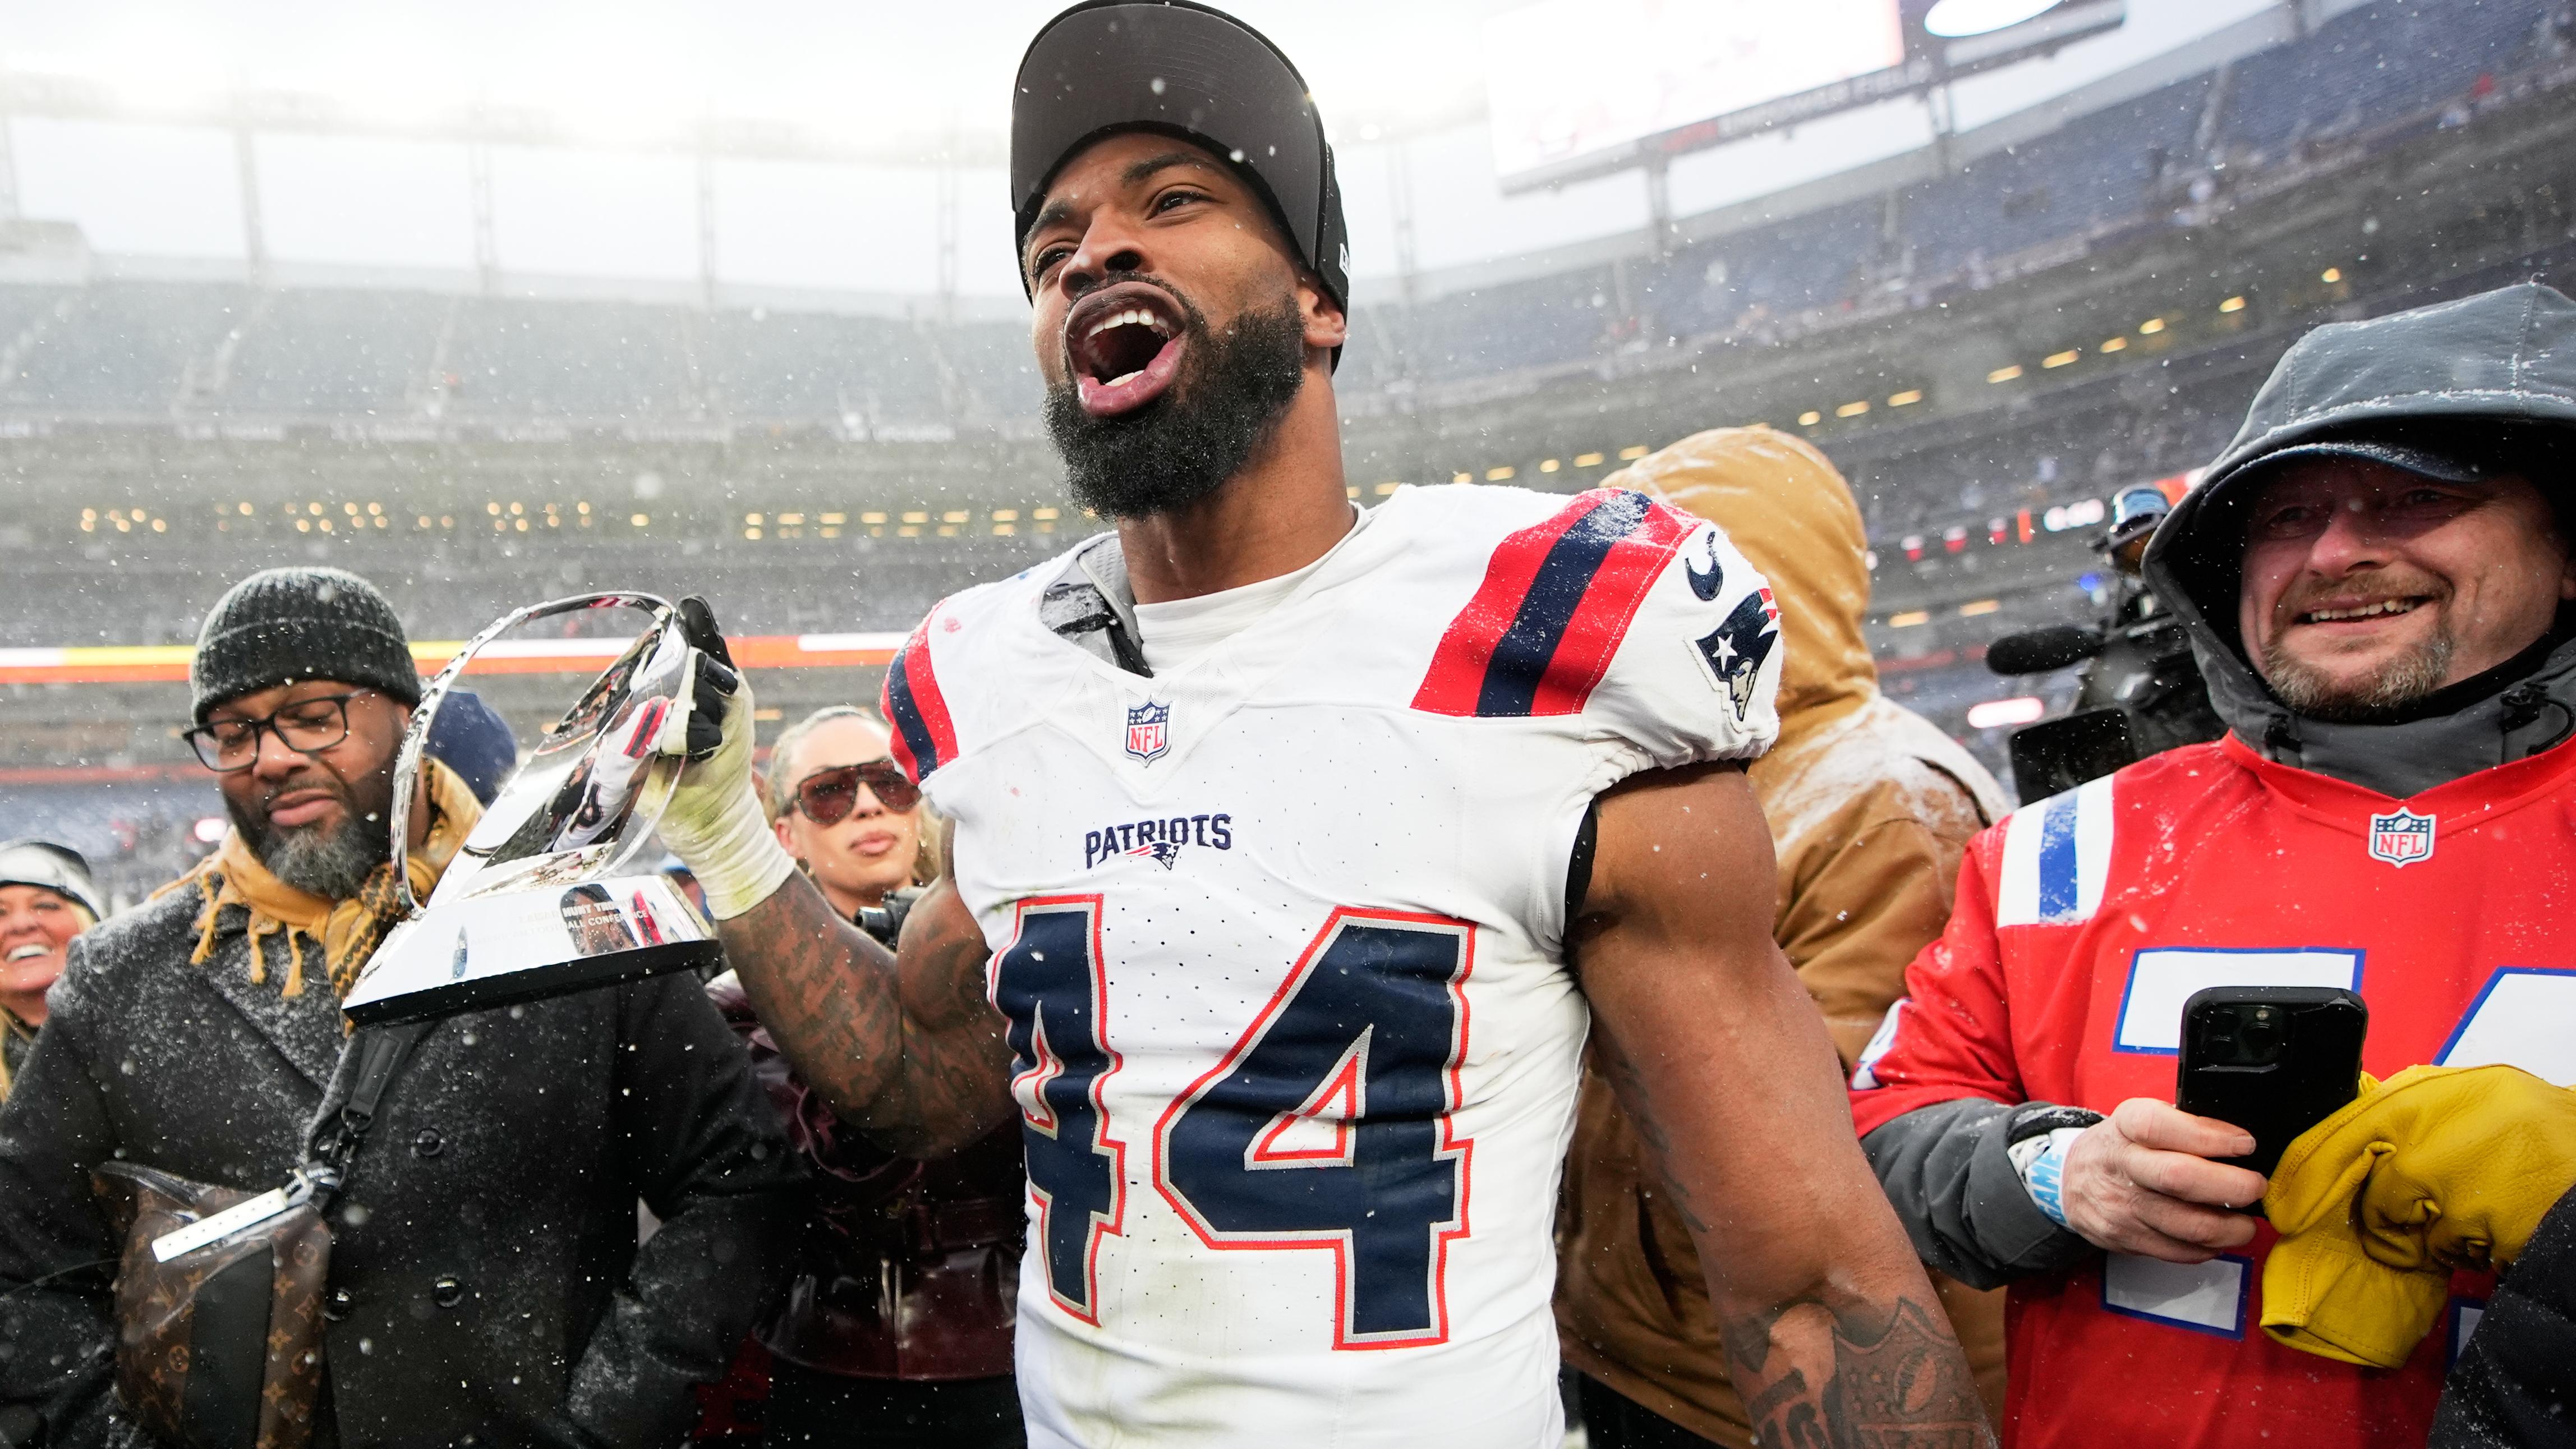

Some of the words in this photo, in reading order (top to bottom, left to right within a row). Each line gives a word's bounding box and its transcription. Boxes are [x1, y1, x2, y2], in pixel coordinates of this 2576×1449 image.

[1129, 725, 1163, 753] NFL
[1085, 813, 1232, 870] PATRIOTS
[2379, 834, 2423, 857] NFL
[562, 904, 592, 917] HUNT
[990, 893, 1477, 1351] 44
